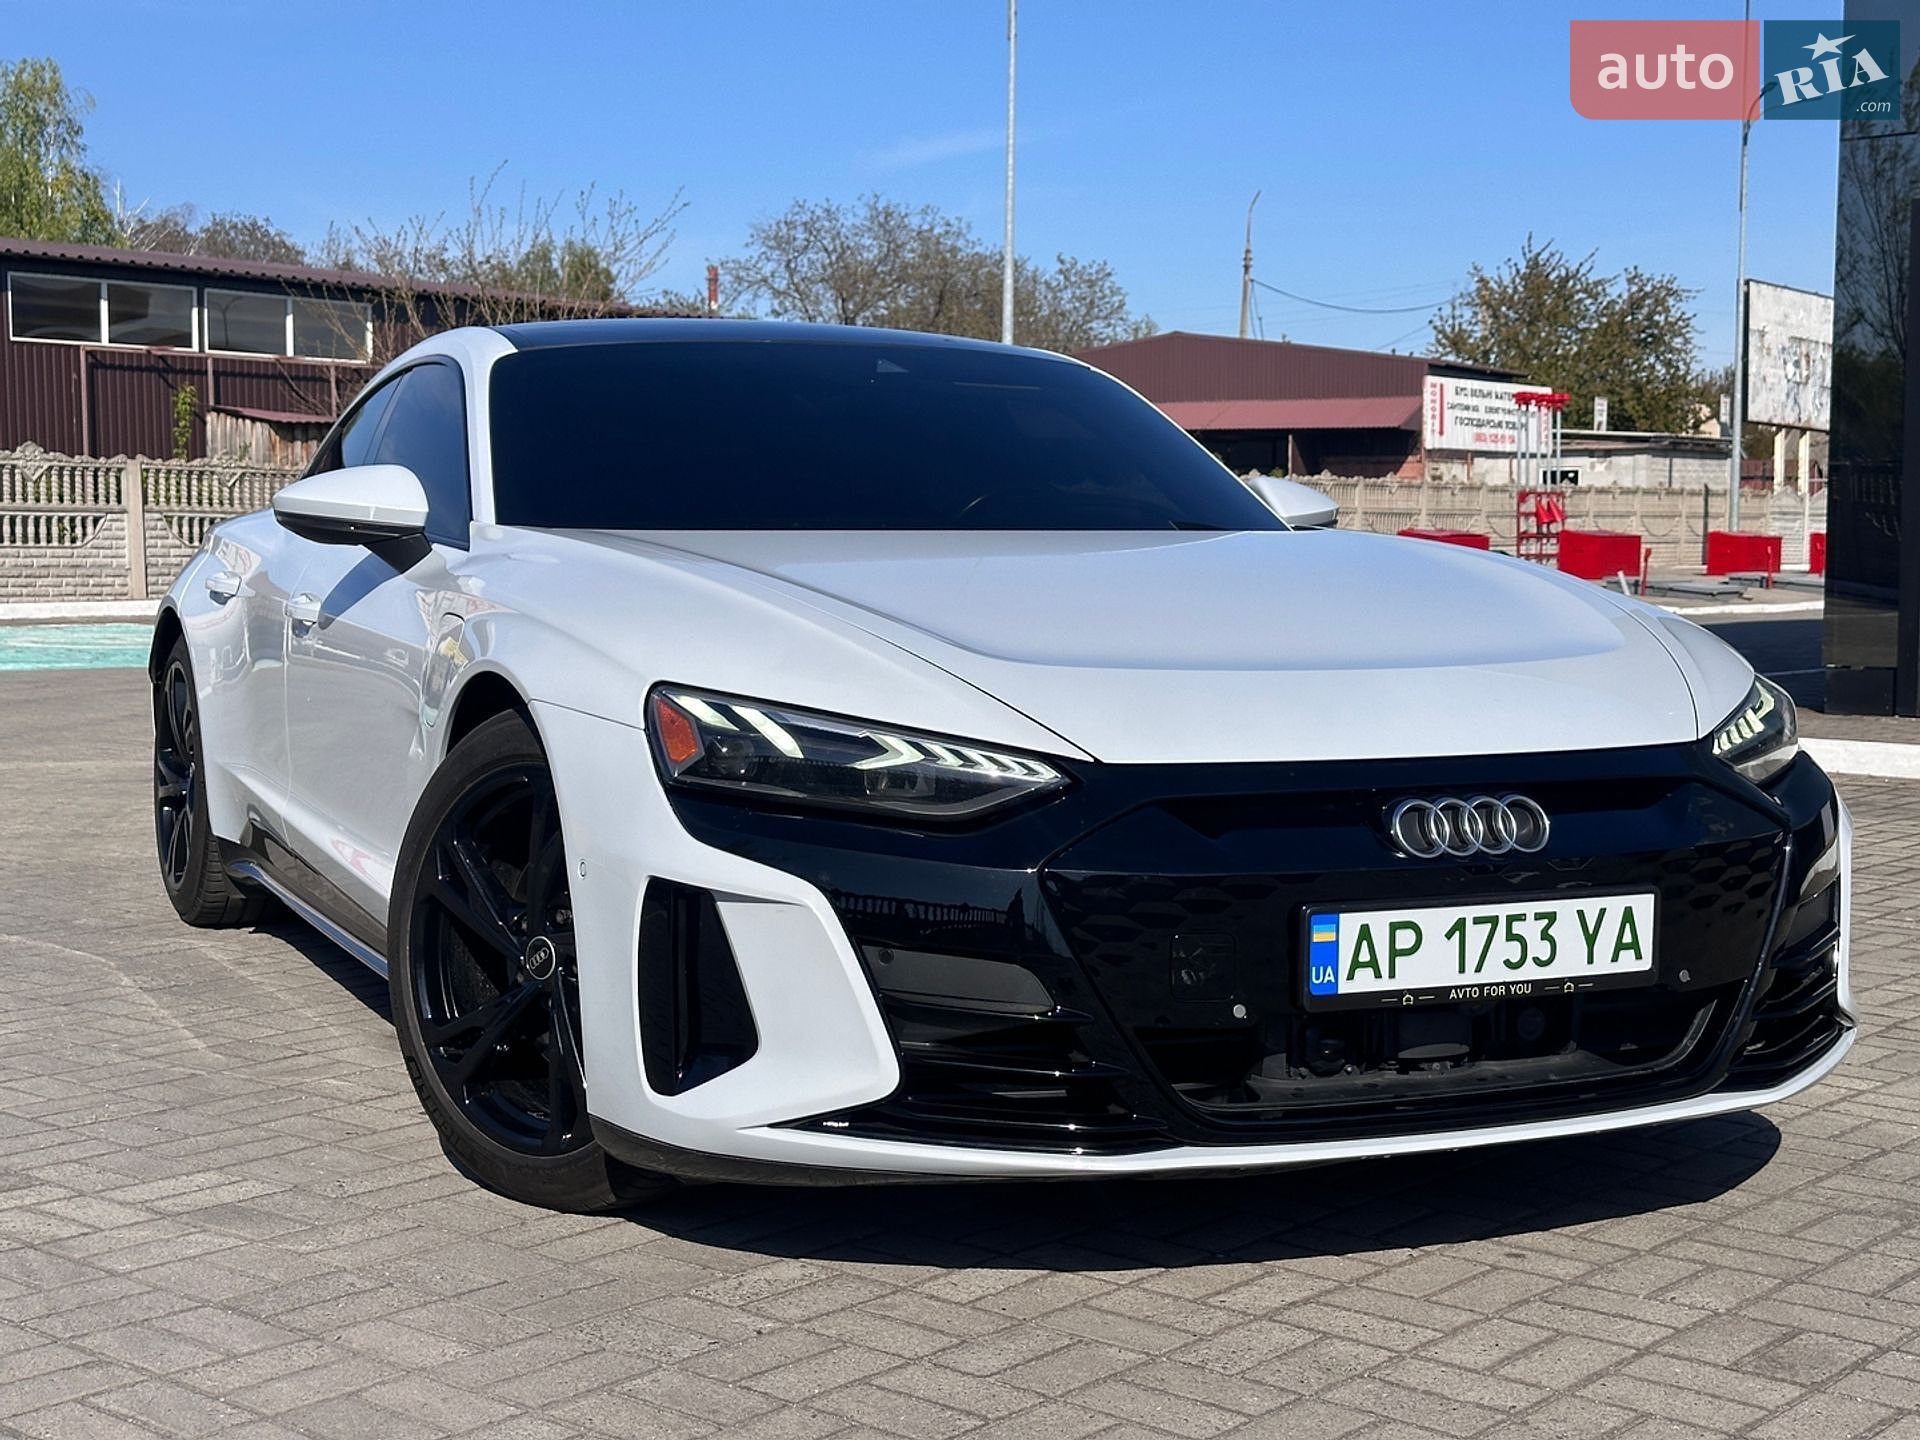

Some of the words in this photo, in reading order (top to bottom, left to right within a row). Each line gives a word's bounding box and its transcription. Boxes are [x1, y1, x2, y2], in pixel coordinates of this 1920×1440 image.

[1346, 920, 1423, 981] AP
[1444, 911, 1557, 974] 1753
[1576, 906, 1643, 965] YA
[1312, 966, 1335, 984] UA
[1449, 986, 1480, 1000] AVTO
[1484, 984, 1506, 997] FOR
[1509, 983, 1532, 995] YOU
